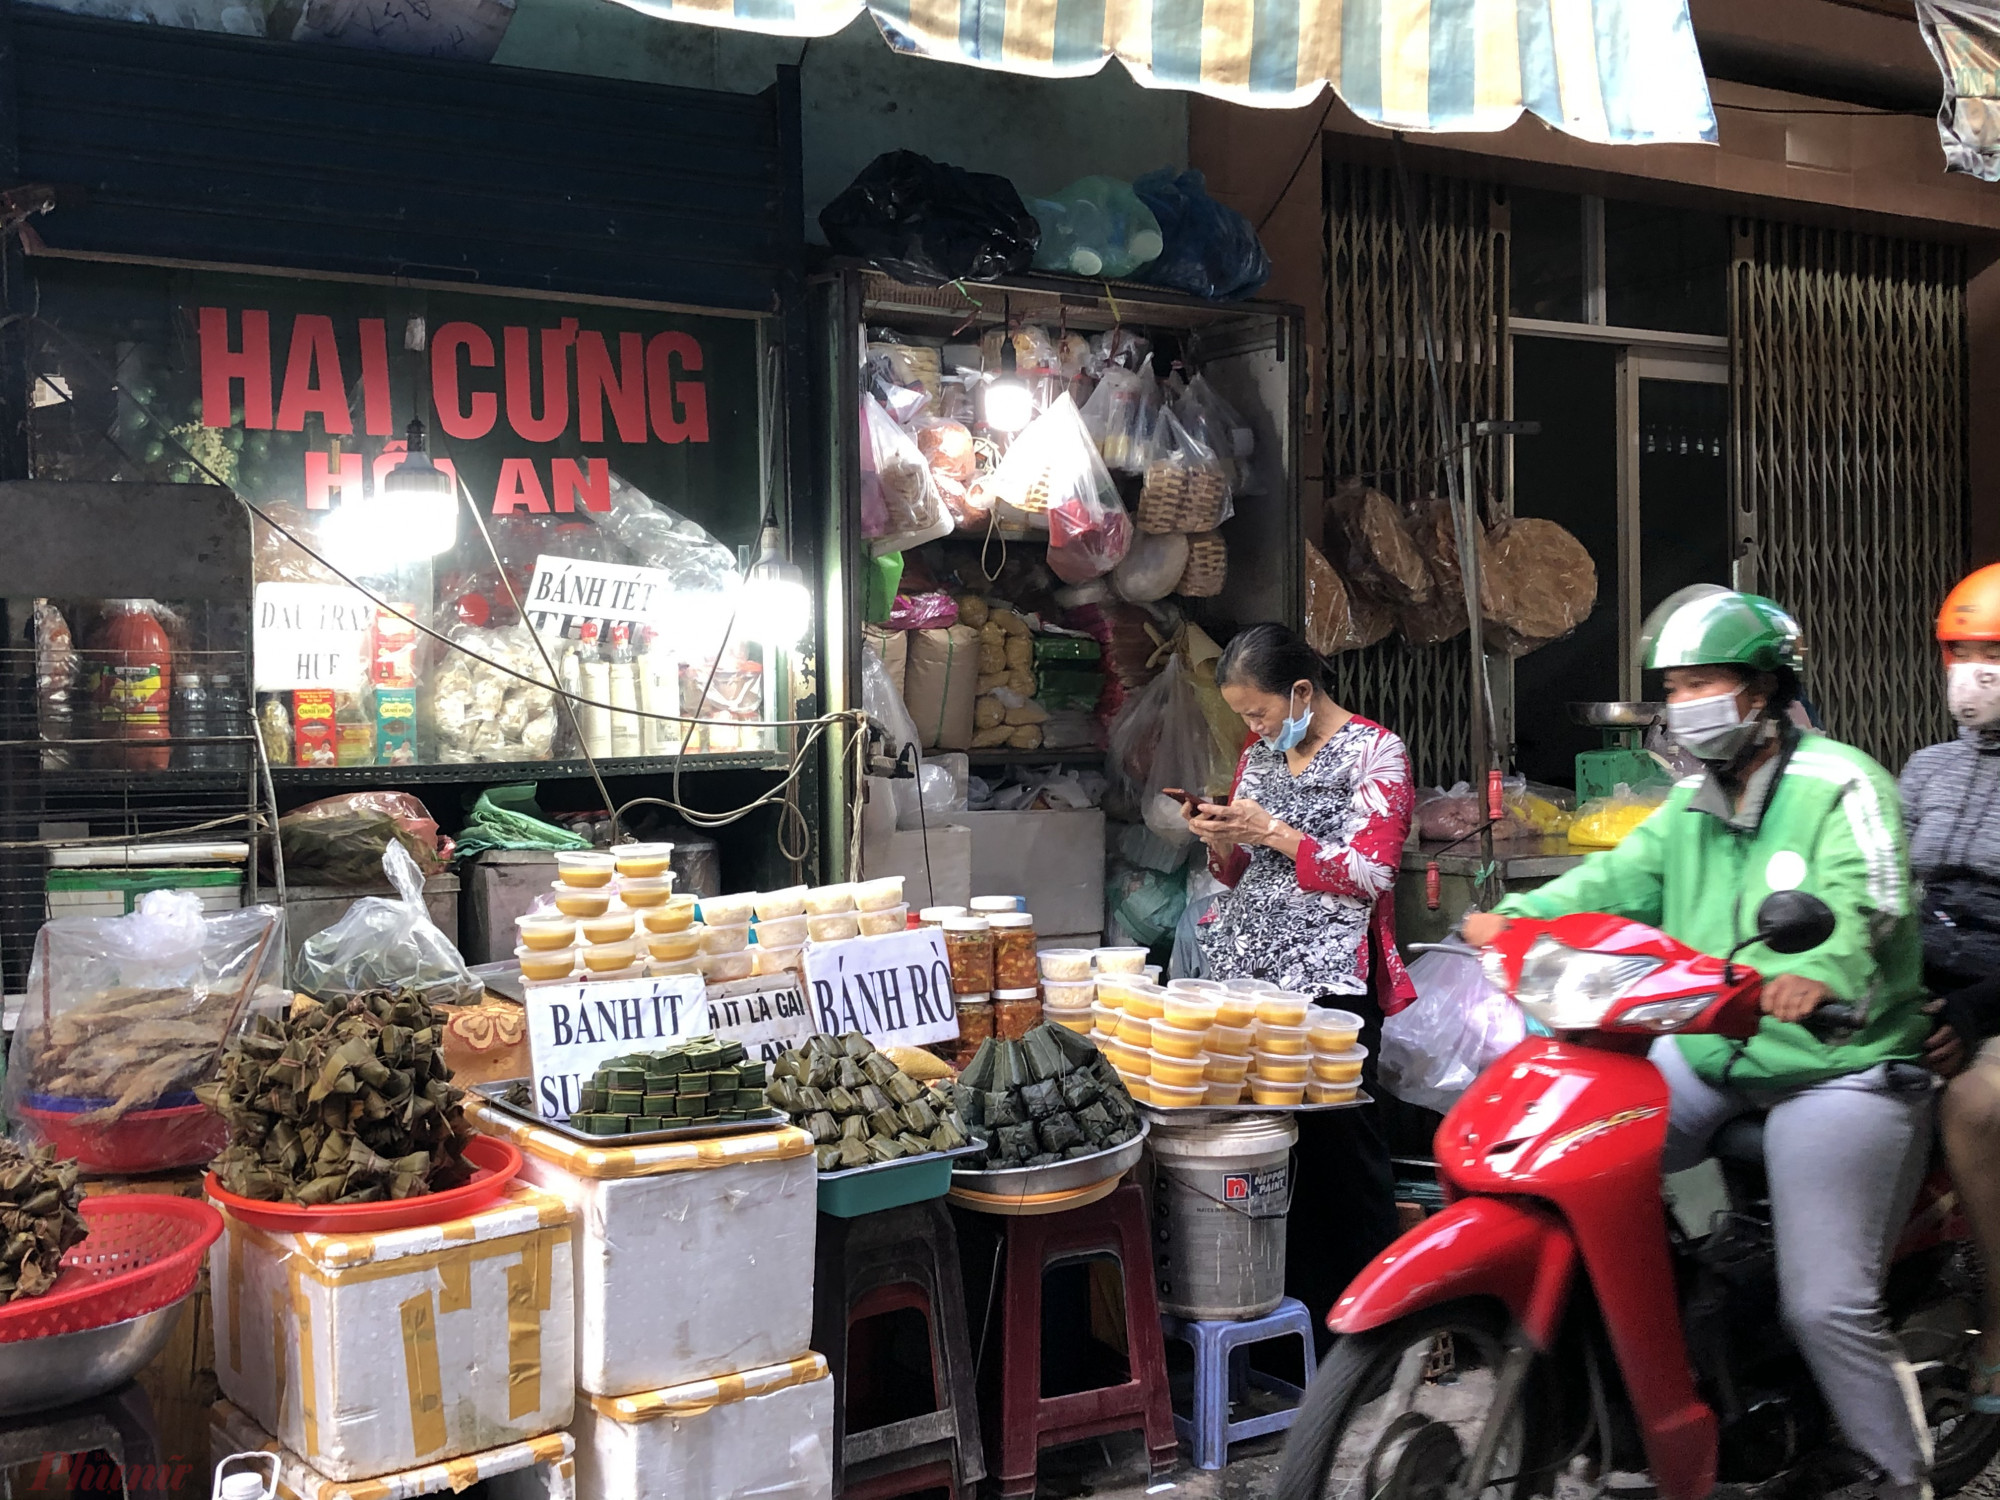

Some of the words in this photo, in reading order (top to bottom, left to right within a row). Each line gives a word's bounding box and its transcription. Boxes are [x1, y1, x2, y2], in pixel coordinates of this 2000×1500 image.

[198, 307, 393, 436] HAI
[431, 318, 710, 444] CƯNG
[492, 457, 612, 515] AN
[534, 564, 607, 607] BÁNH
[720, 994, 741, 1027] ÍT
[775, 989, 806, 1018] GAI
[812, 955, 909, 1037] BÁNH
[906, 941, 955, 1026] RÒ
[549, 988, 645, 1046] BÁNH
[650, 983, 684, 1038] ÍT
[1254, 1169, 1286, 1185] NIPPON
[1258, 1180, 1285, 1194] PAINT
